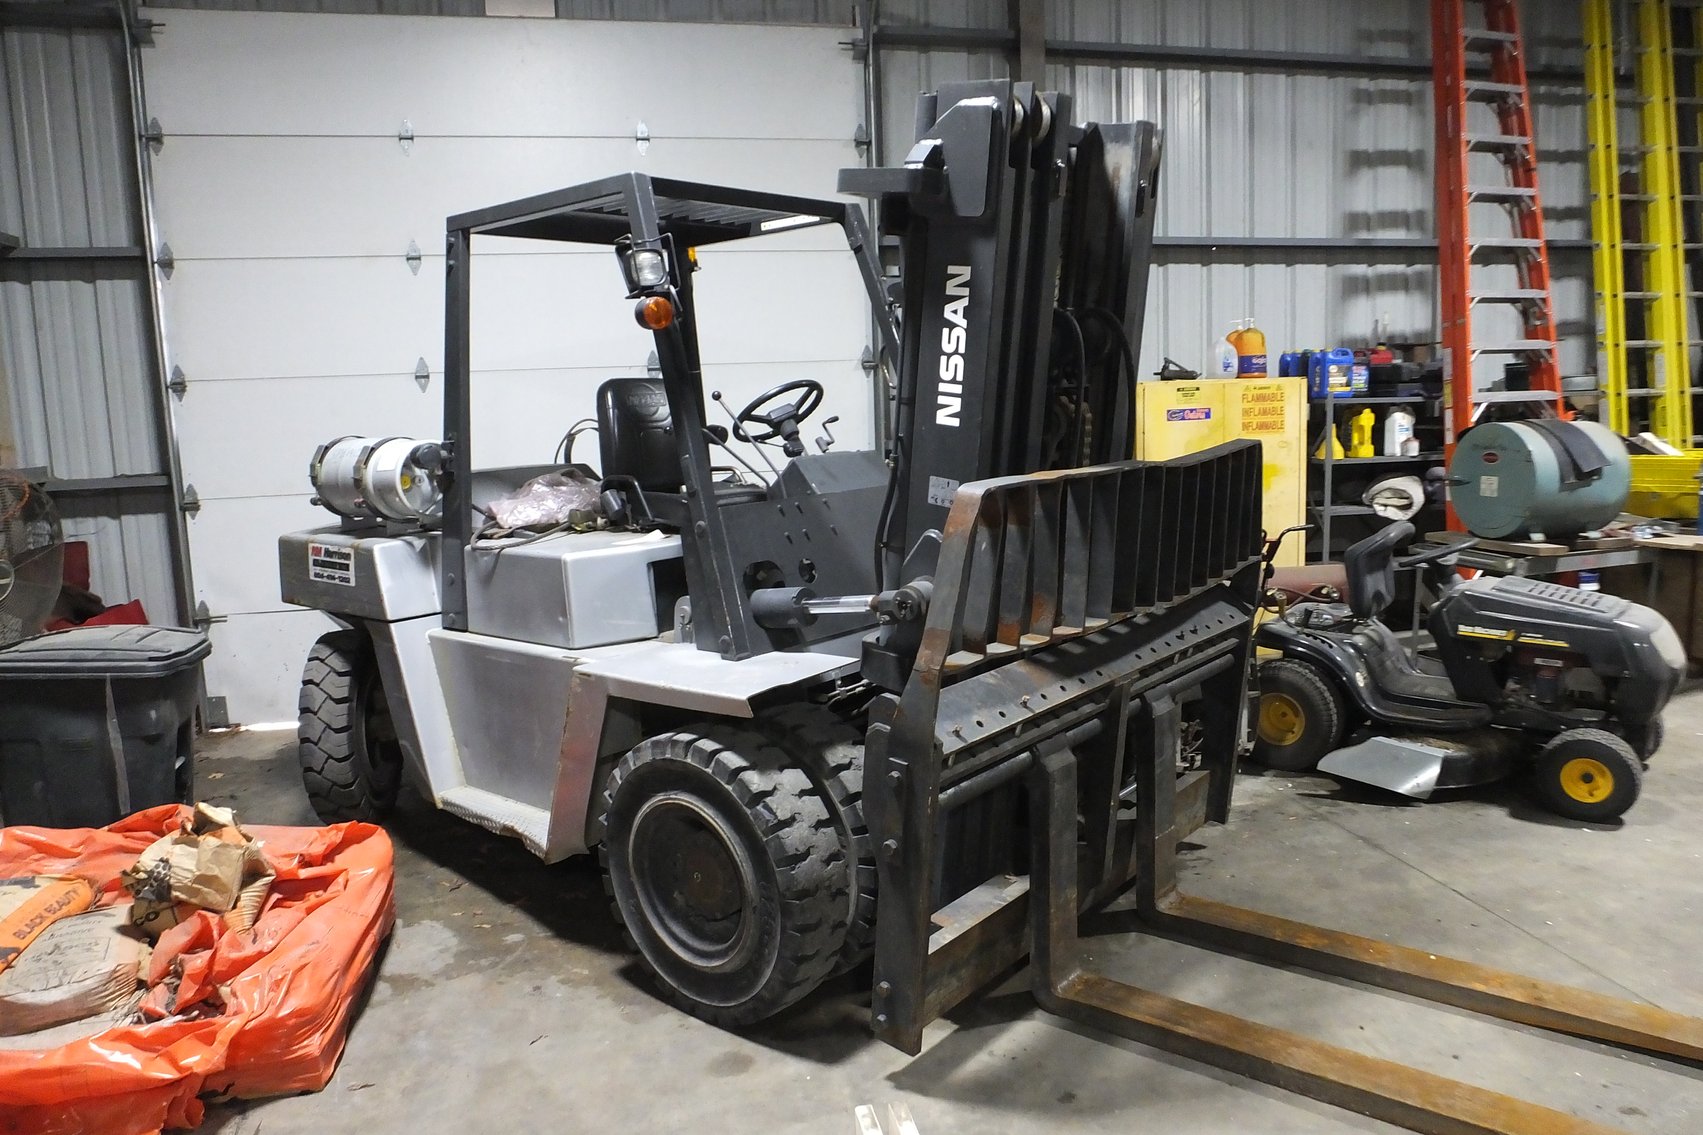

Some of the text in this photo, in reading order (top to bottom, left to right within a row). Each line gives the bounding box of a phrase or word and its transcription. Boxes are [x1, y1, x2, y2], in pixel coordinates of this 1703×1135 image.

[936, 265, 971, 427] NISSAN
[1242, 392, 1284, 403] FLAMMABLE
[13, 912, 47, 940] BLACK
[44, 888, 80, 915] BEAUTY
